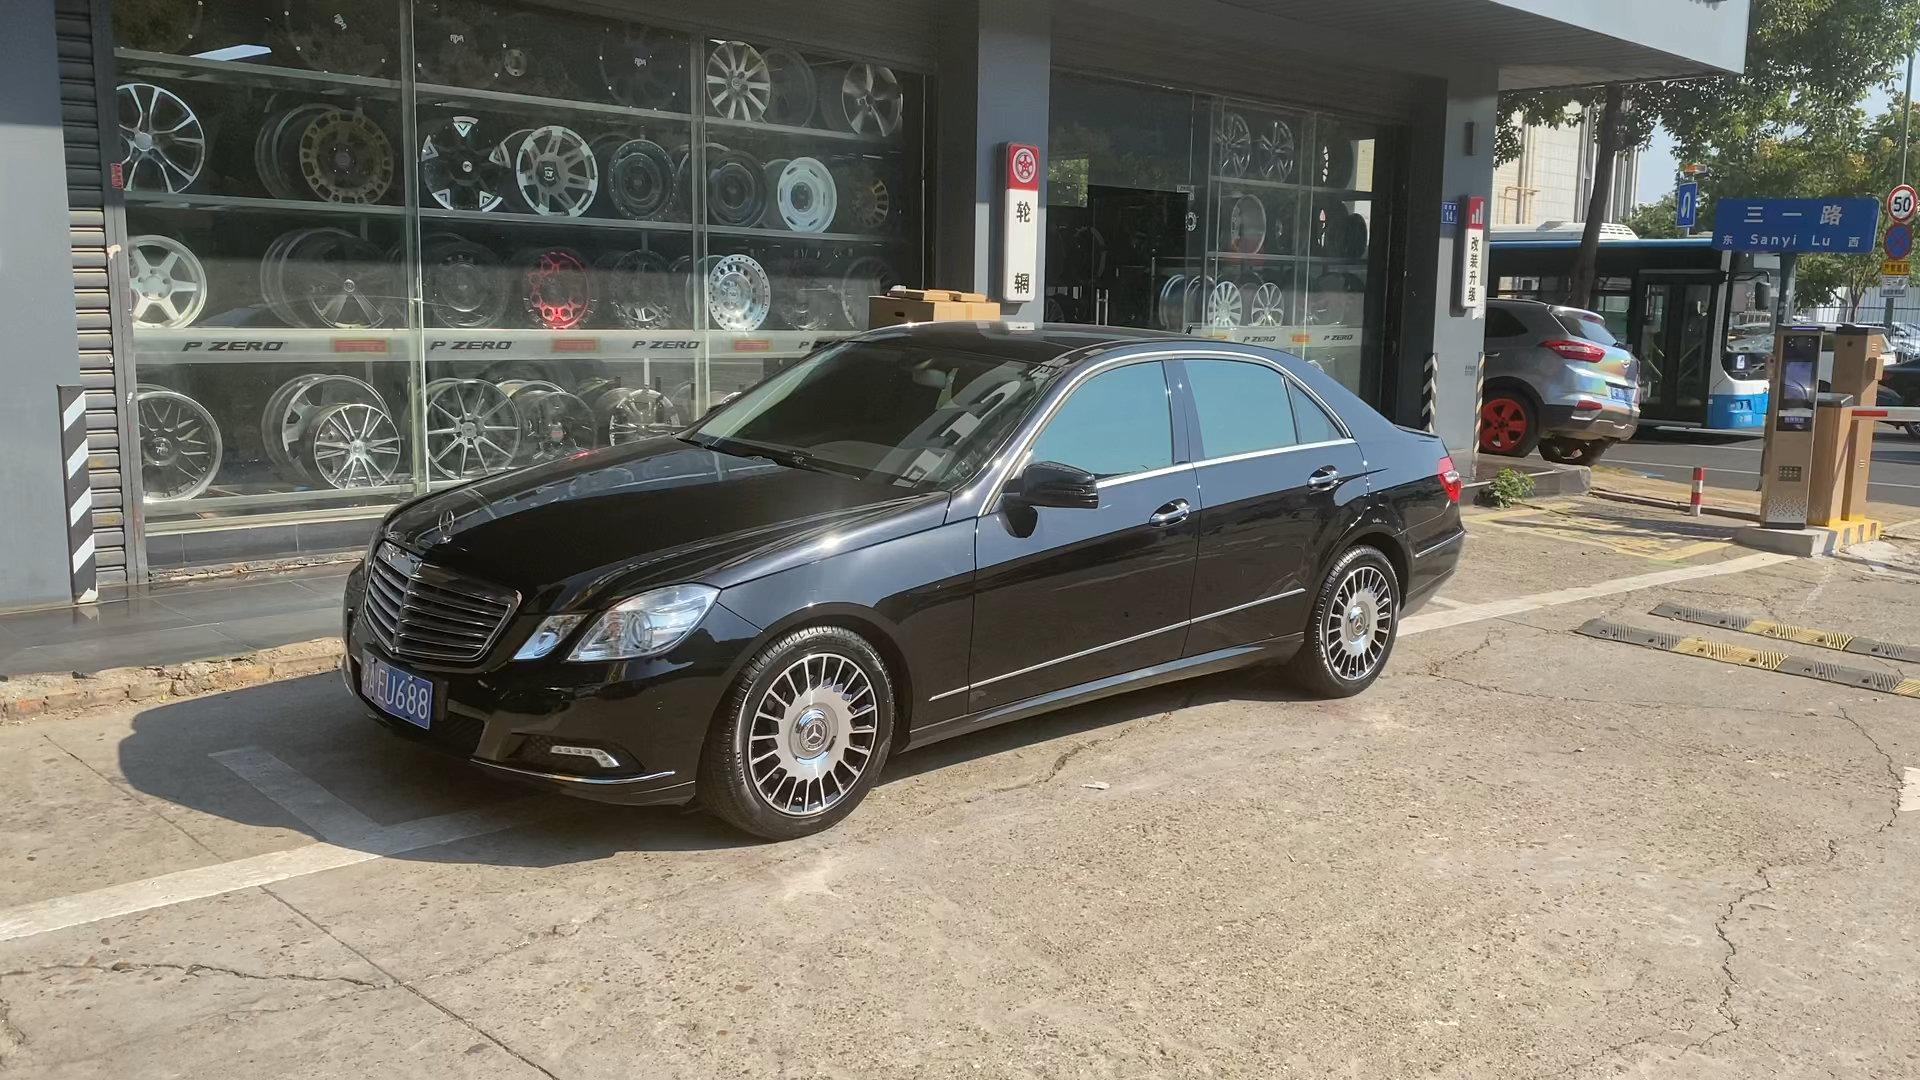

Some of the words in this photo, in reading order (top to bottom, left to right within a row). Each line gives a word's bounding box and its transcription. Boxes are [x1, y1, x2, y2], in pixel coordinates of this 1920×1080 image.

[1893, 196, 1911, 213] 50
[1743, 204, 1843, 226] 三一路
[1014, 200, 1031, 294] 轮辋
[1722, 235, 1733, 245] 东
[1750, 234, 1797, 248] Sanyi
[1811, 235, 1831, 246] Lu
[1848, 236, 1860, 248] 西
[1468, 236, 1480, 302] 改装升级
[430, 341, 446, 350] P
[451, 341, 513, 350] ZERO
[632, 341, 646, 349] P
[649, 341, 700, 349] ZERO
[1251, 335, 1276, 343] ZERO
[182, 341, 202, 352] P
[207, 341, 284, 352] ZERO
